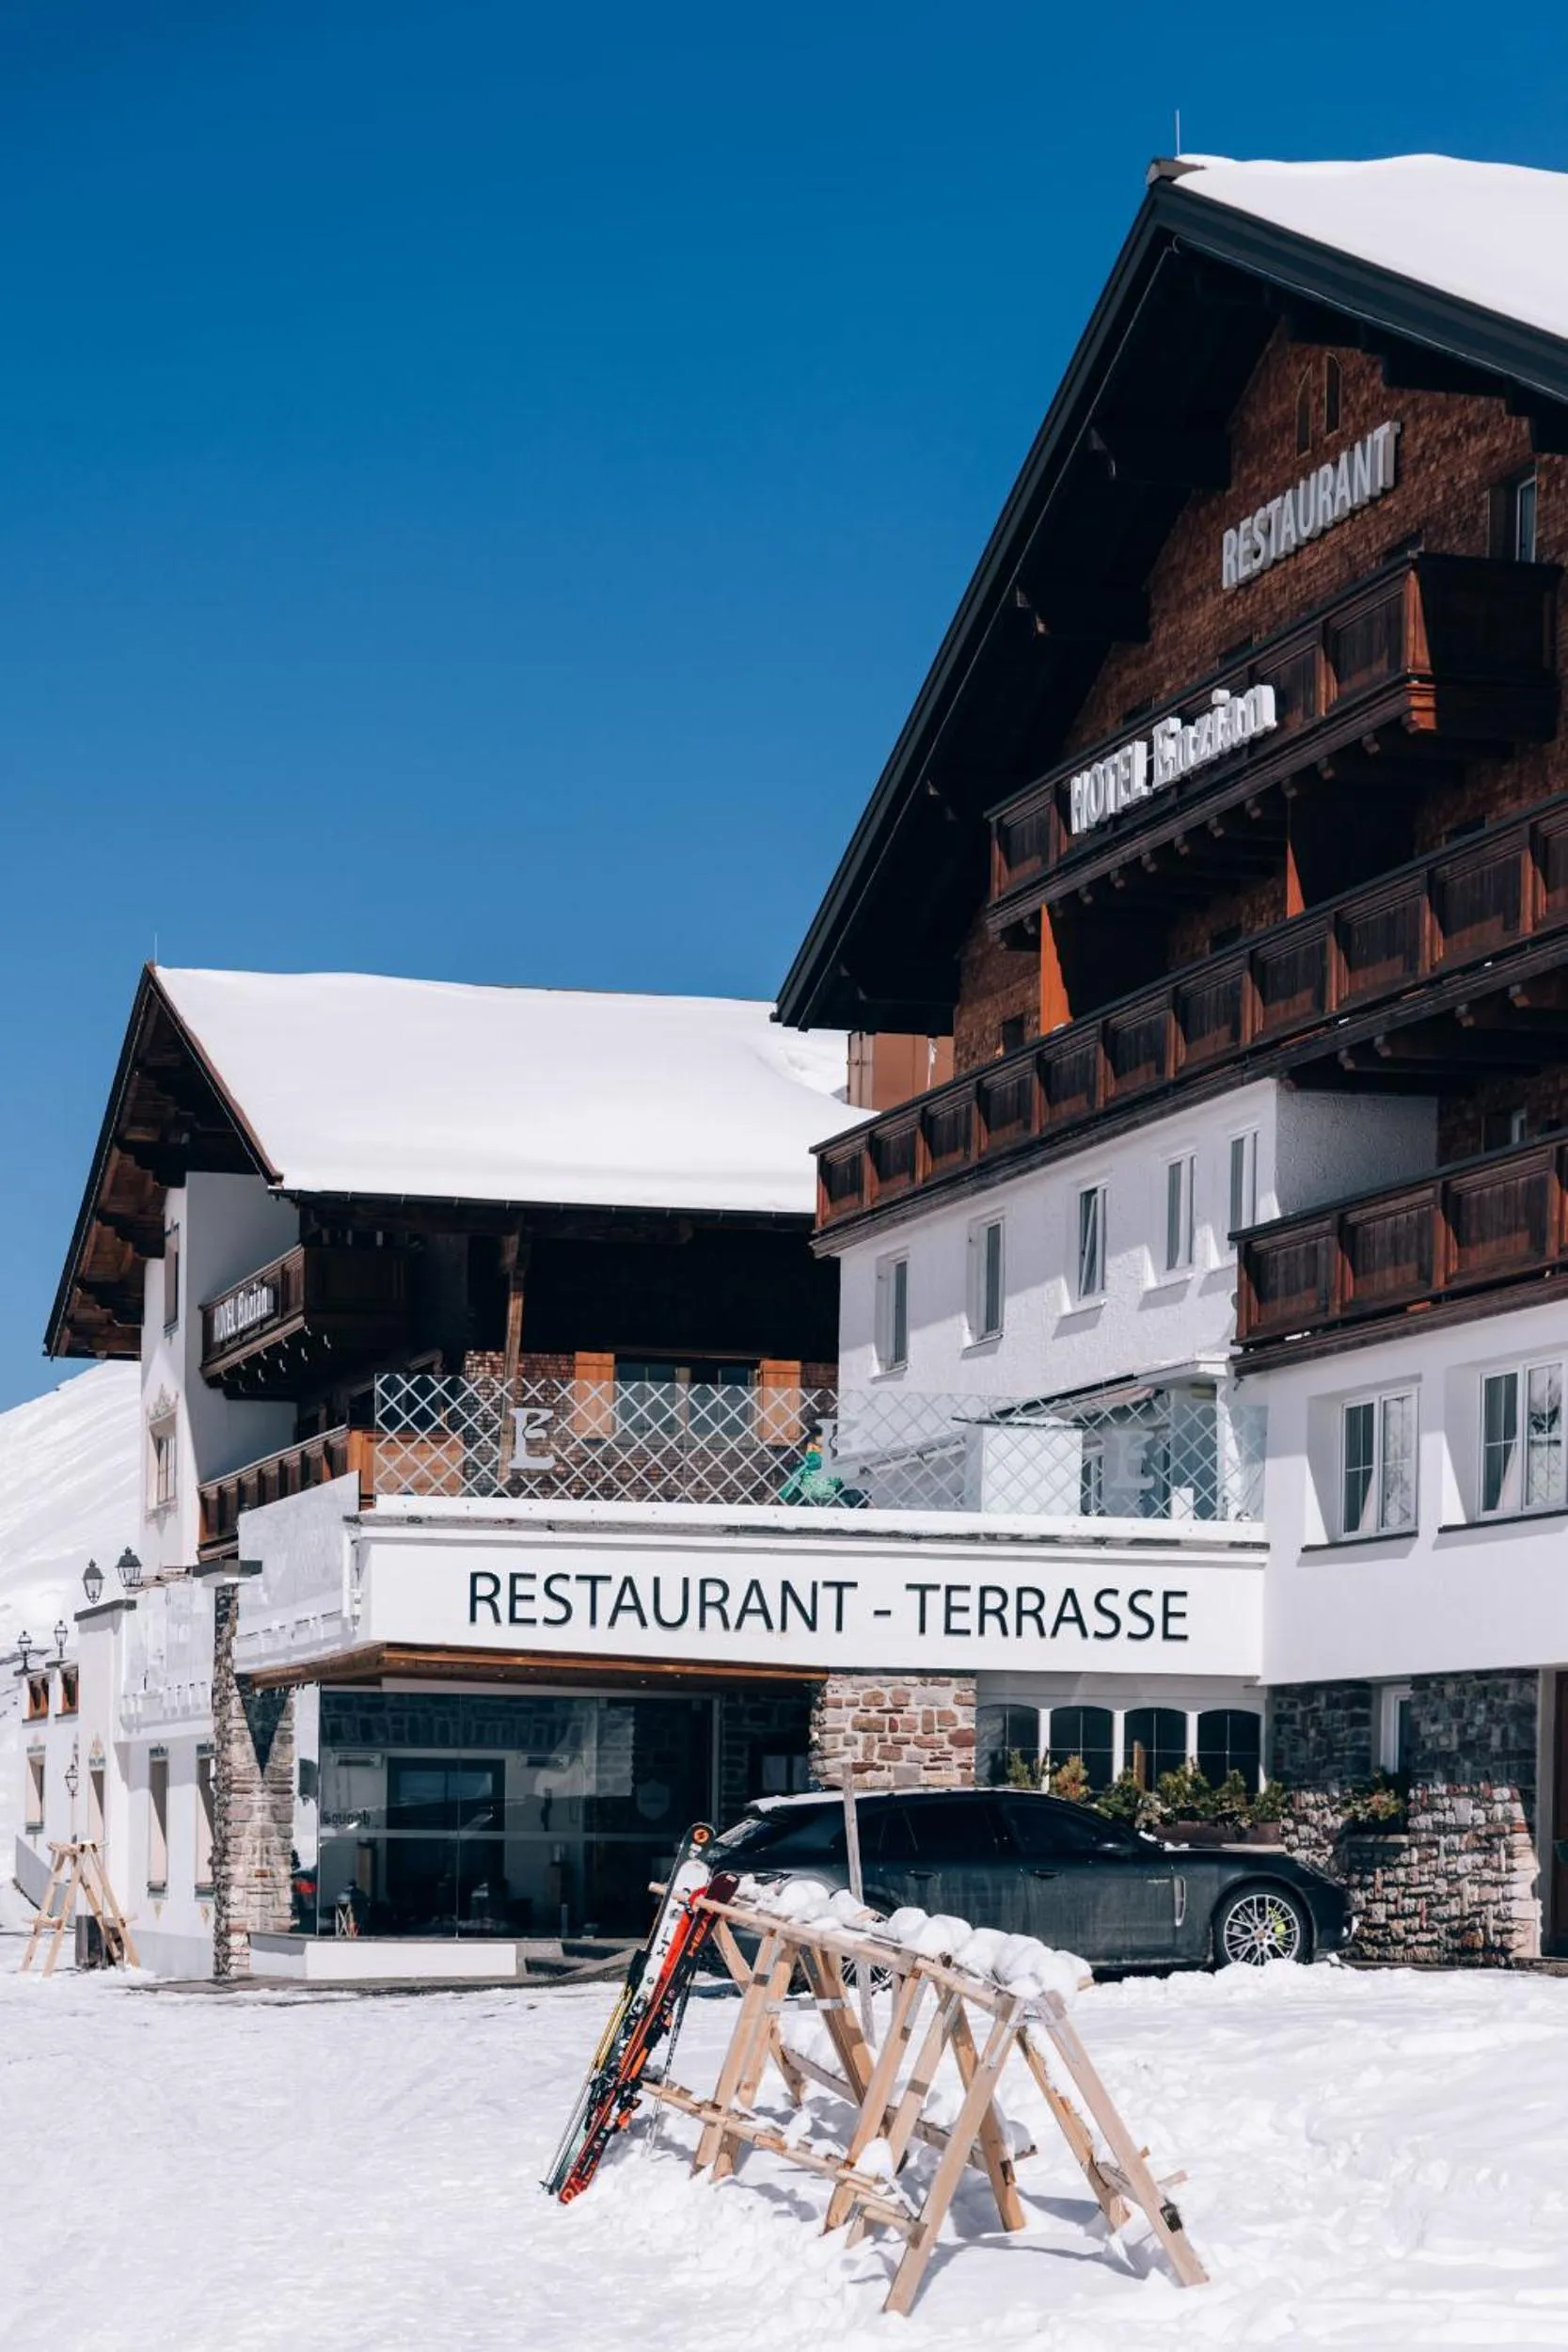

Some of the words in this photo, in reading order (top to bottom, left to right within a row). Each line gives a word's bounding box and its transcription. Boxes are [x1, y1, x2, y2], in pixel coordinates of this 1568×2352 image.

[1222, 421, 1400, 591] RESTAURANT
[1070, 741, 1153, 834] HOTEL
[469, 1571, 859, 1633] RESTAURANT
[905, 1582, 1189, 1642] TERRASSE
